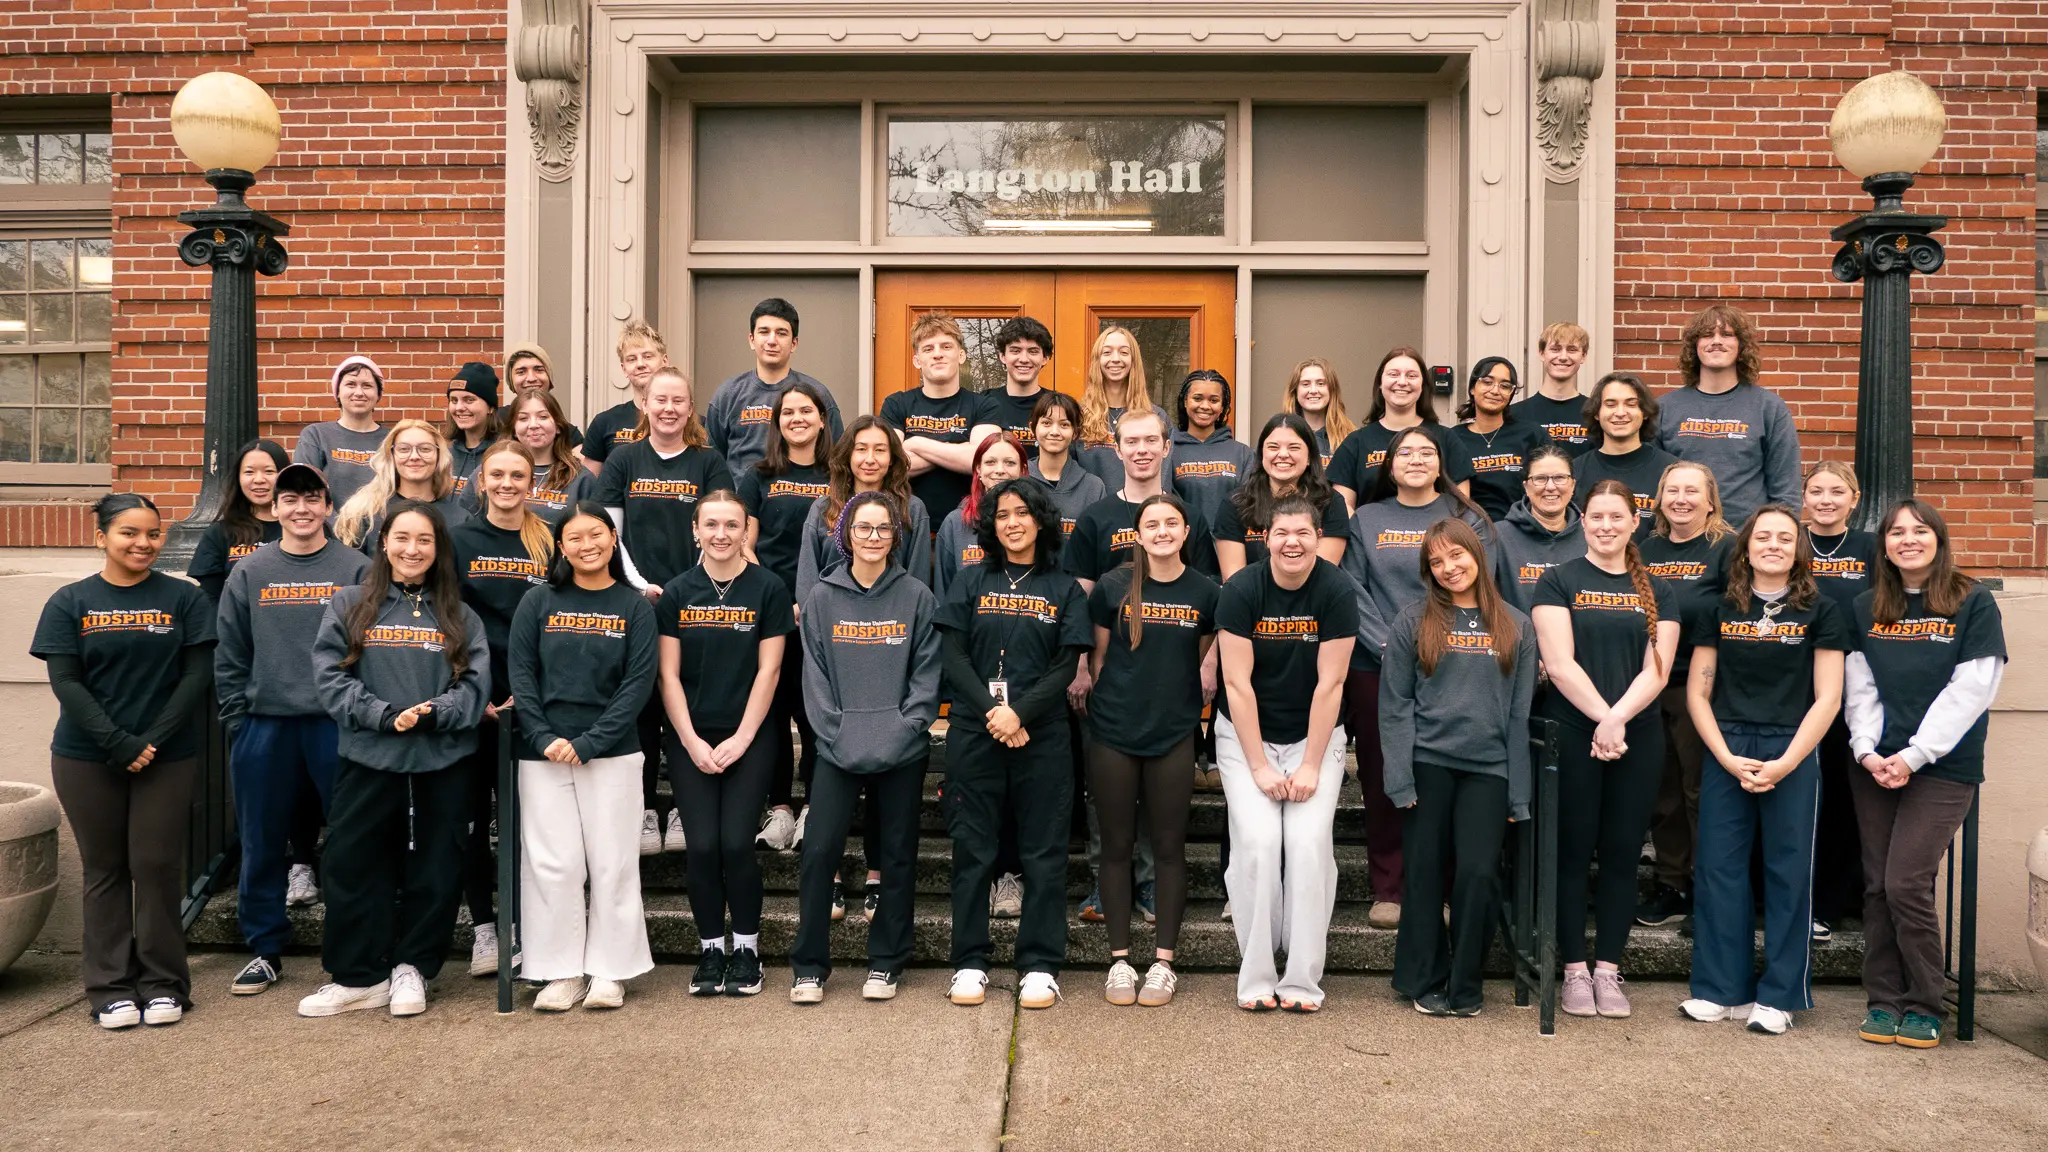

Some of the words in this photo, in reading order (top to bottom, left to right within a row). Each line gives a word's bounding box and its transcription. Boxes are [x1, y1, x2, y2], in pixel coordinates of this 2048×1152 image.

[914, 161, 1097, 200] Langton
[1109, 160, 1203, 194] Hall
[905, 417, 967, 429] KIDSPIRIT
[1680, 421, 1749, 433] KIDSPIRIT
[1549, 427, 1588, 437] SPIRIT
[1176, 463, 1237, 475] KIDSPIRIT
[631, 481, 698, 495] KIDSPIRIT
[769, 483, 830, 496] KIDSPIRI
[980, 596, 1058, 617] KIDSPIRT
[1575, 593, 1644, 607] KIDSPIR
[679, 609, 756, 623] KIDSPIRIT
[1125, 605, 1200, 621] KDSPIRIT
[82, 613, 173, 629] KIDSPIRIT
[548, 615, 626, 631] KIDSPIRIT
[365, 629, 445, 643] KIDSPIRIT
[833, 623, 907, 638] KIDSPIRIT
[1872, 622, 1957, 637] KIDSPIRIT
